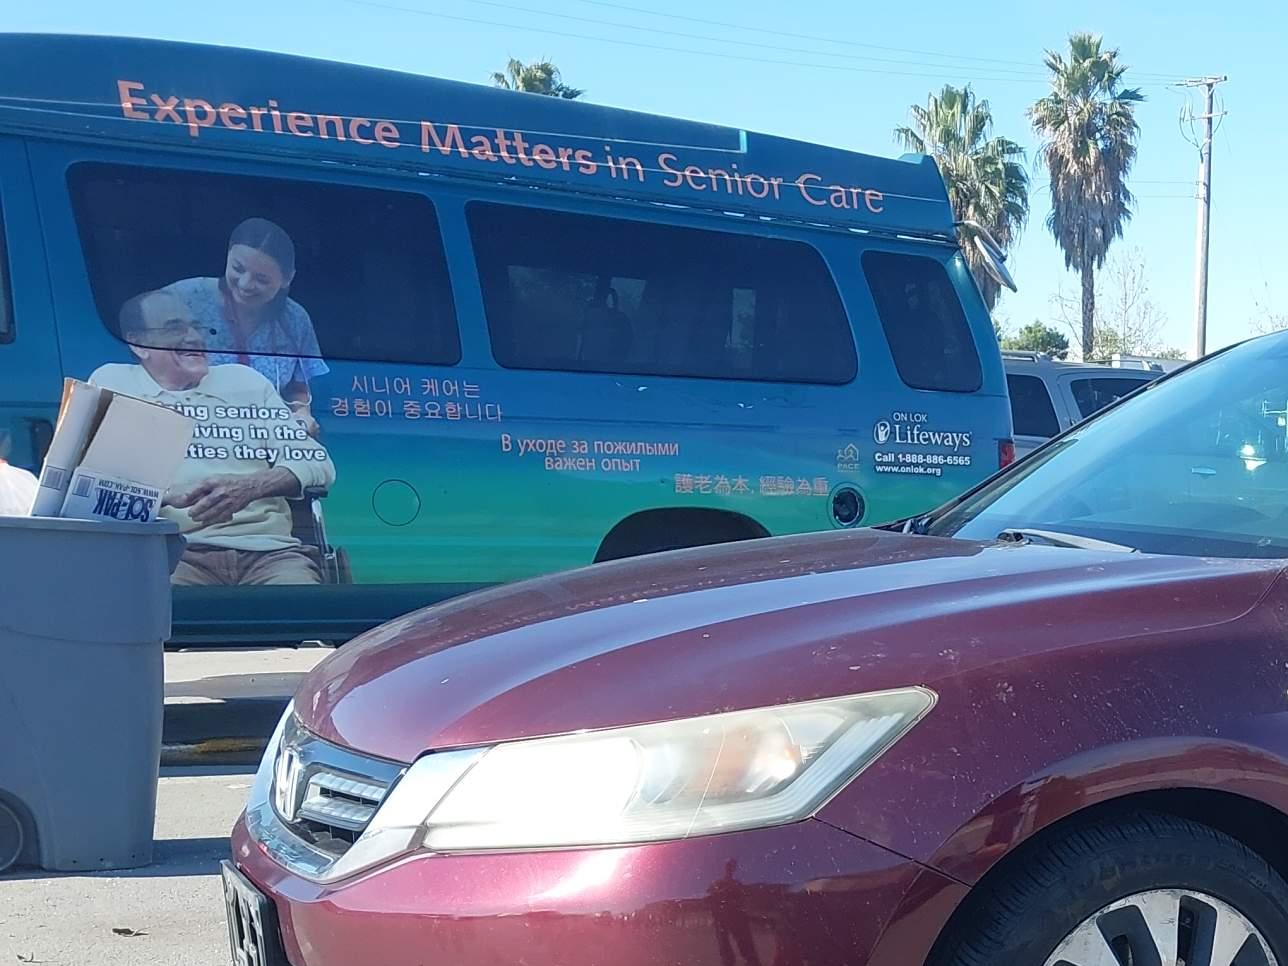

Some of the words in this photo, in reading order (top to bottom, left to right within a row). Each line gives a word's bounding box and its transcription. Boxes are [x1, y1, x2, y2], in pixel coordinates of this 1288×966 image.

[117, 79, 400, 148] Experience
[420, 120, 598, 175] Matters
[605, 145, 645, 182] in
[658, 153, 783, 200] Senior
[797, 173, 884, 213] Care
[351, 375, 411, 396] 시니어
[421, 378, 480, 399] 케어는
[215, 406, 289, 419] seniors
[330, 397, 393, 418] 경험이
[403, 400, 503, 422] 중요합니다
[893, 412, 908, 422] ON
[910, 413, 928, 422] LOK
[192, 424, 243, 441] iving
[249, 425, 268, 440] in
[274, 425, 307, 440] the
[895, 424, 971, 452] Lifeways
[186, 444, 227, 459] ties
[234, 445, 278, 462] they
[285, 446, 326, 460] love
[501, 434, 512, 452] В
[518, 438, 566, 456] уходе
[573, 440, 588, 454] за
[594, 440, 679, 456] пожилыми
[545, 457, 596, 471] важен
[601, 458, 640, 472] опыт
[875, 453, 895, 462] Call
[898, 454, 971, 465] 1-888-886-6565
[876, 465, 942, 476] www.onlok.org
